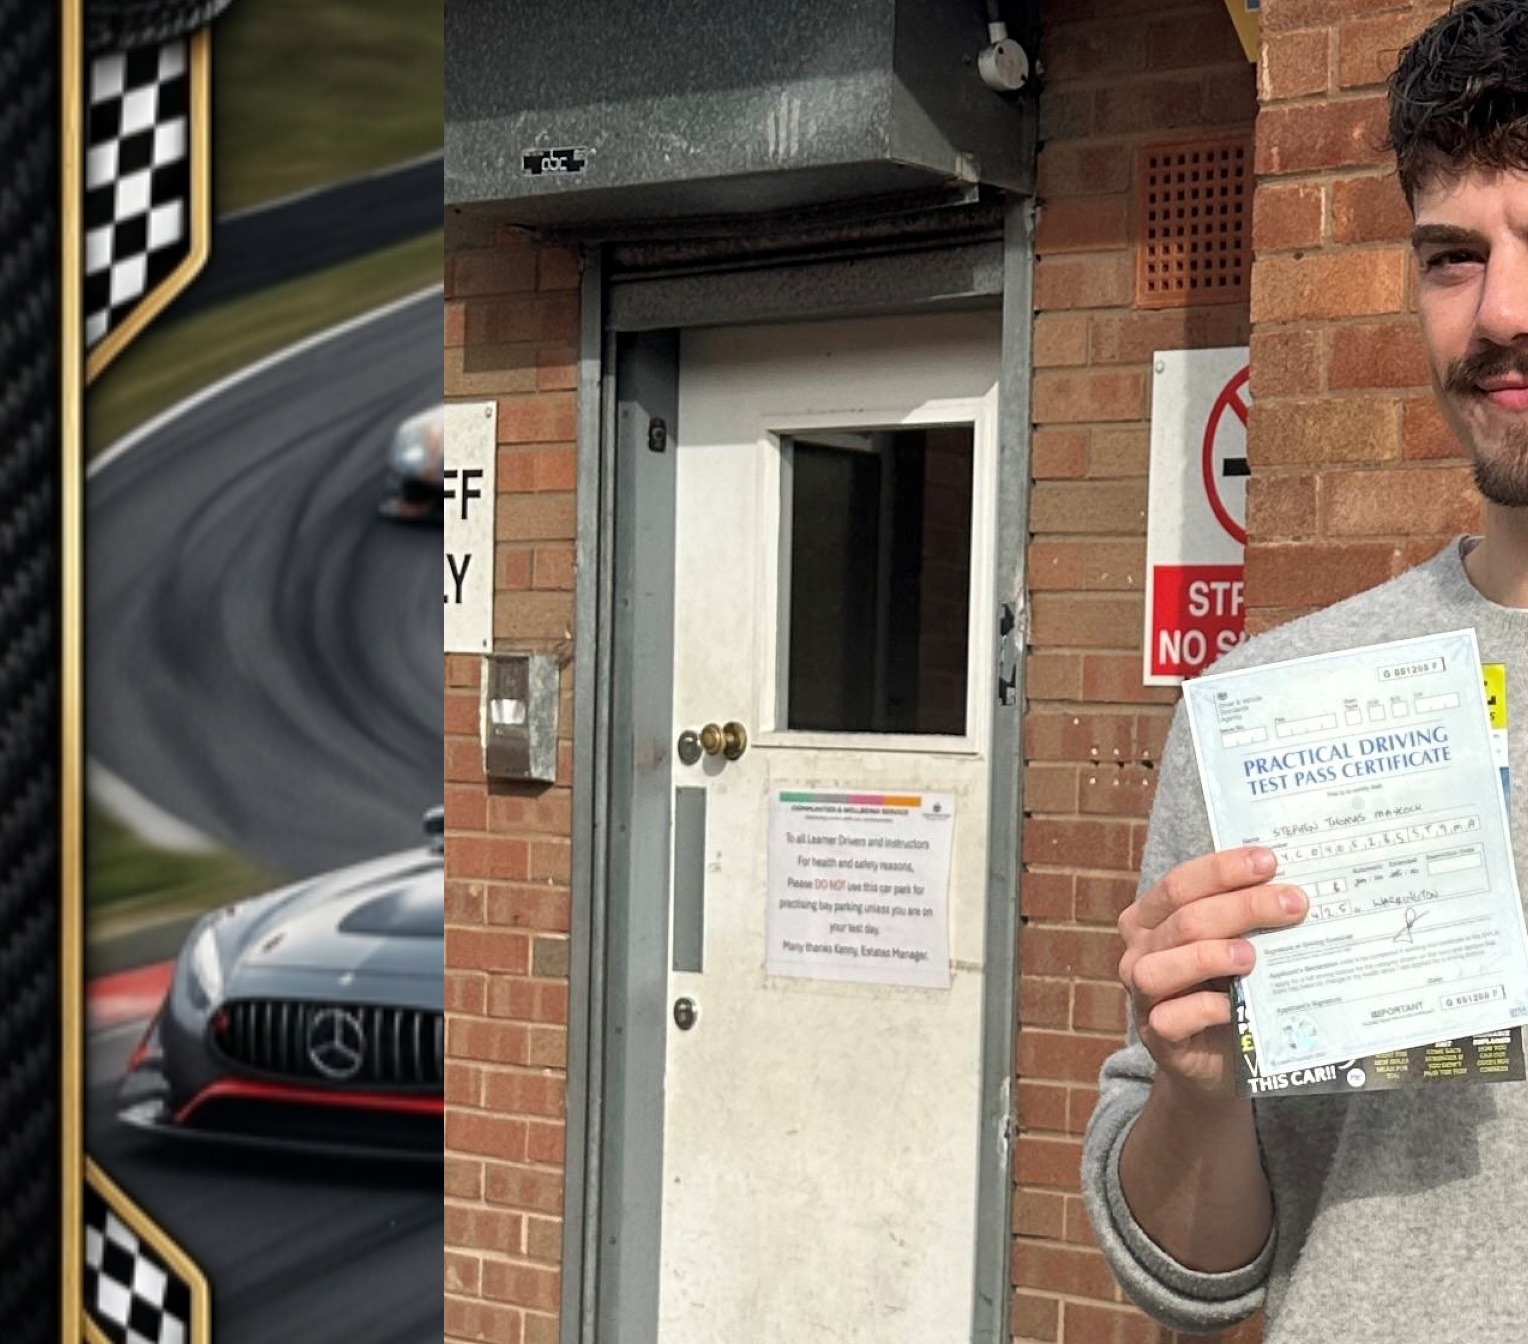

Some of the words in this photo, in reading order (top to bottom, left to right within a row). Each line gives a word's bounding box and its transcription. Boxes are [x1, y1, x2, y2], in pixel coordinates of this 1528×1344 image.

[444, 554, 472, 604] Y
[1159, 629, 1207, 665] NO
[1216, 629, 1246, 658] S
[1243, 742, 1353, 778] PRACTICAL
[1359, 726, 1449, 756] DRIVING
[1247, 775, 1288, 796] TEST
[1295, 767, 1337, 788] PASS
[1342, 746, 1452, 778] CERTIFICATE
[786, 832, 795, 843] To
[795, 833, 806, 844] all
[807, 834, 837, 846] Learner
[838, 835, 866, 847] Drivers
[868, 837, 884, 847] and
[798, 855, 811, 867] For
[812, 856, 837, 867] health
[838, 858, 854, 868] and
[855, 858, 878, 872] safety
[787, 877, 813, 889] Please
[814, 879, 828, 890] DO
[829, 879, 847, 891] NOT
[848, 883, 861, 891] use
[863, 881, 877, 892] this
[879, 884, 892, 893] car
[894, 884, 911, 895] park
[913, 883, 925, 895] for
[819, 901, 832, 912] bay
[834, 902, 863, 915] parking
[865, 904, 889, 915] unless
[891, 906, 906, 916] you
[907, 907, 921, 916] are
[922, 907, 933, 917] on
[829, 923, 847, 934] your
[848, 923, 863, 933] test
[783, 940, 803, 954] Many
[805, 941, 832, 954] thanks
[861, 945, 890, 957] Estates
[1370, 1001, 1424, 1018] IMPORTANT
[1247, 1073, 1289, 1093] THIS
[1291, 1064, 1337, 1086] CAR!!
